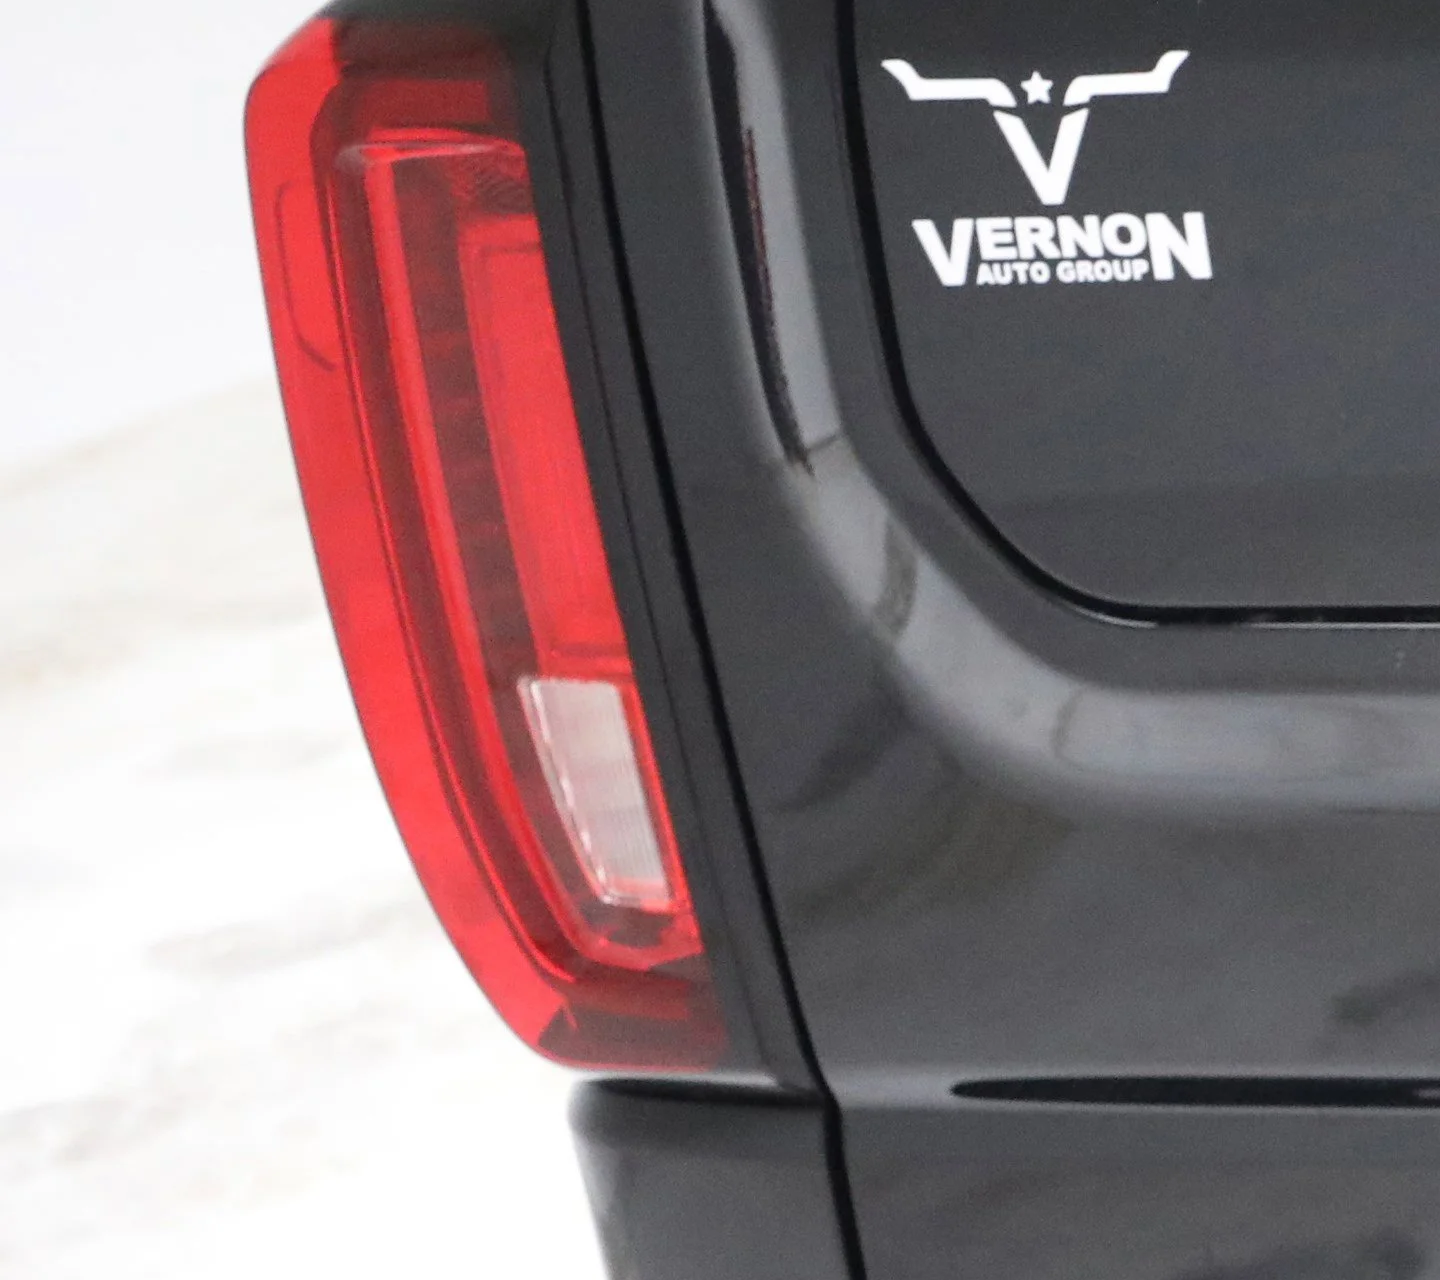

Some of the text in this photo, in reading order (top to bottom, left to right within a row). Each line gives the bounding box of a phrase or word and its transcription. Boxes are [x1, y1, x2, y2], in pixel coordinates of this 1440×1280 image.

[911, 211, 1213, 287] VERNON
[976, 258, 1150, 286] AUTO GROUP
